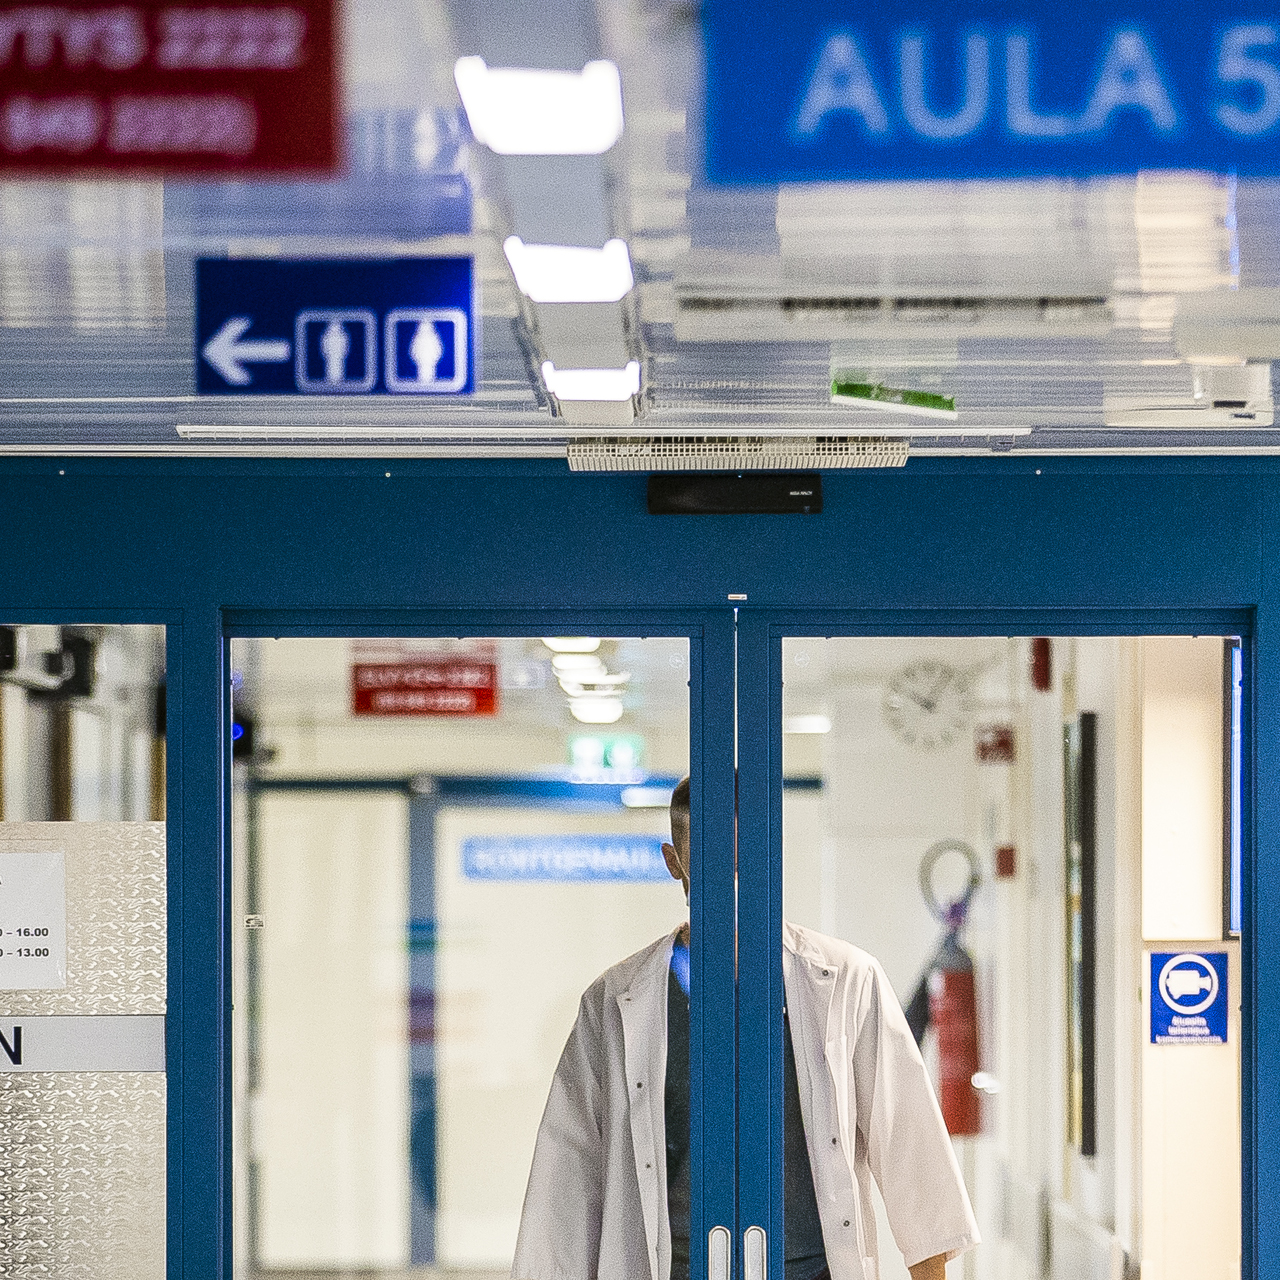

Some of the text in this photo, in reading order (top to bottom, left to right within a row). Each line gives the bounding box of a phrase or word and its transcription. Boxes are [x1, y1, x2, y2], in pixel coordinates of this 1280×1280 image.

[793, 28, 1181, 140] AULA
[16, 927, 49, 937] 16.00
[16, 947, 49, 957] 13.00
